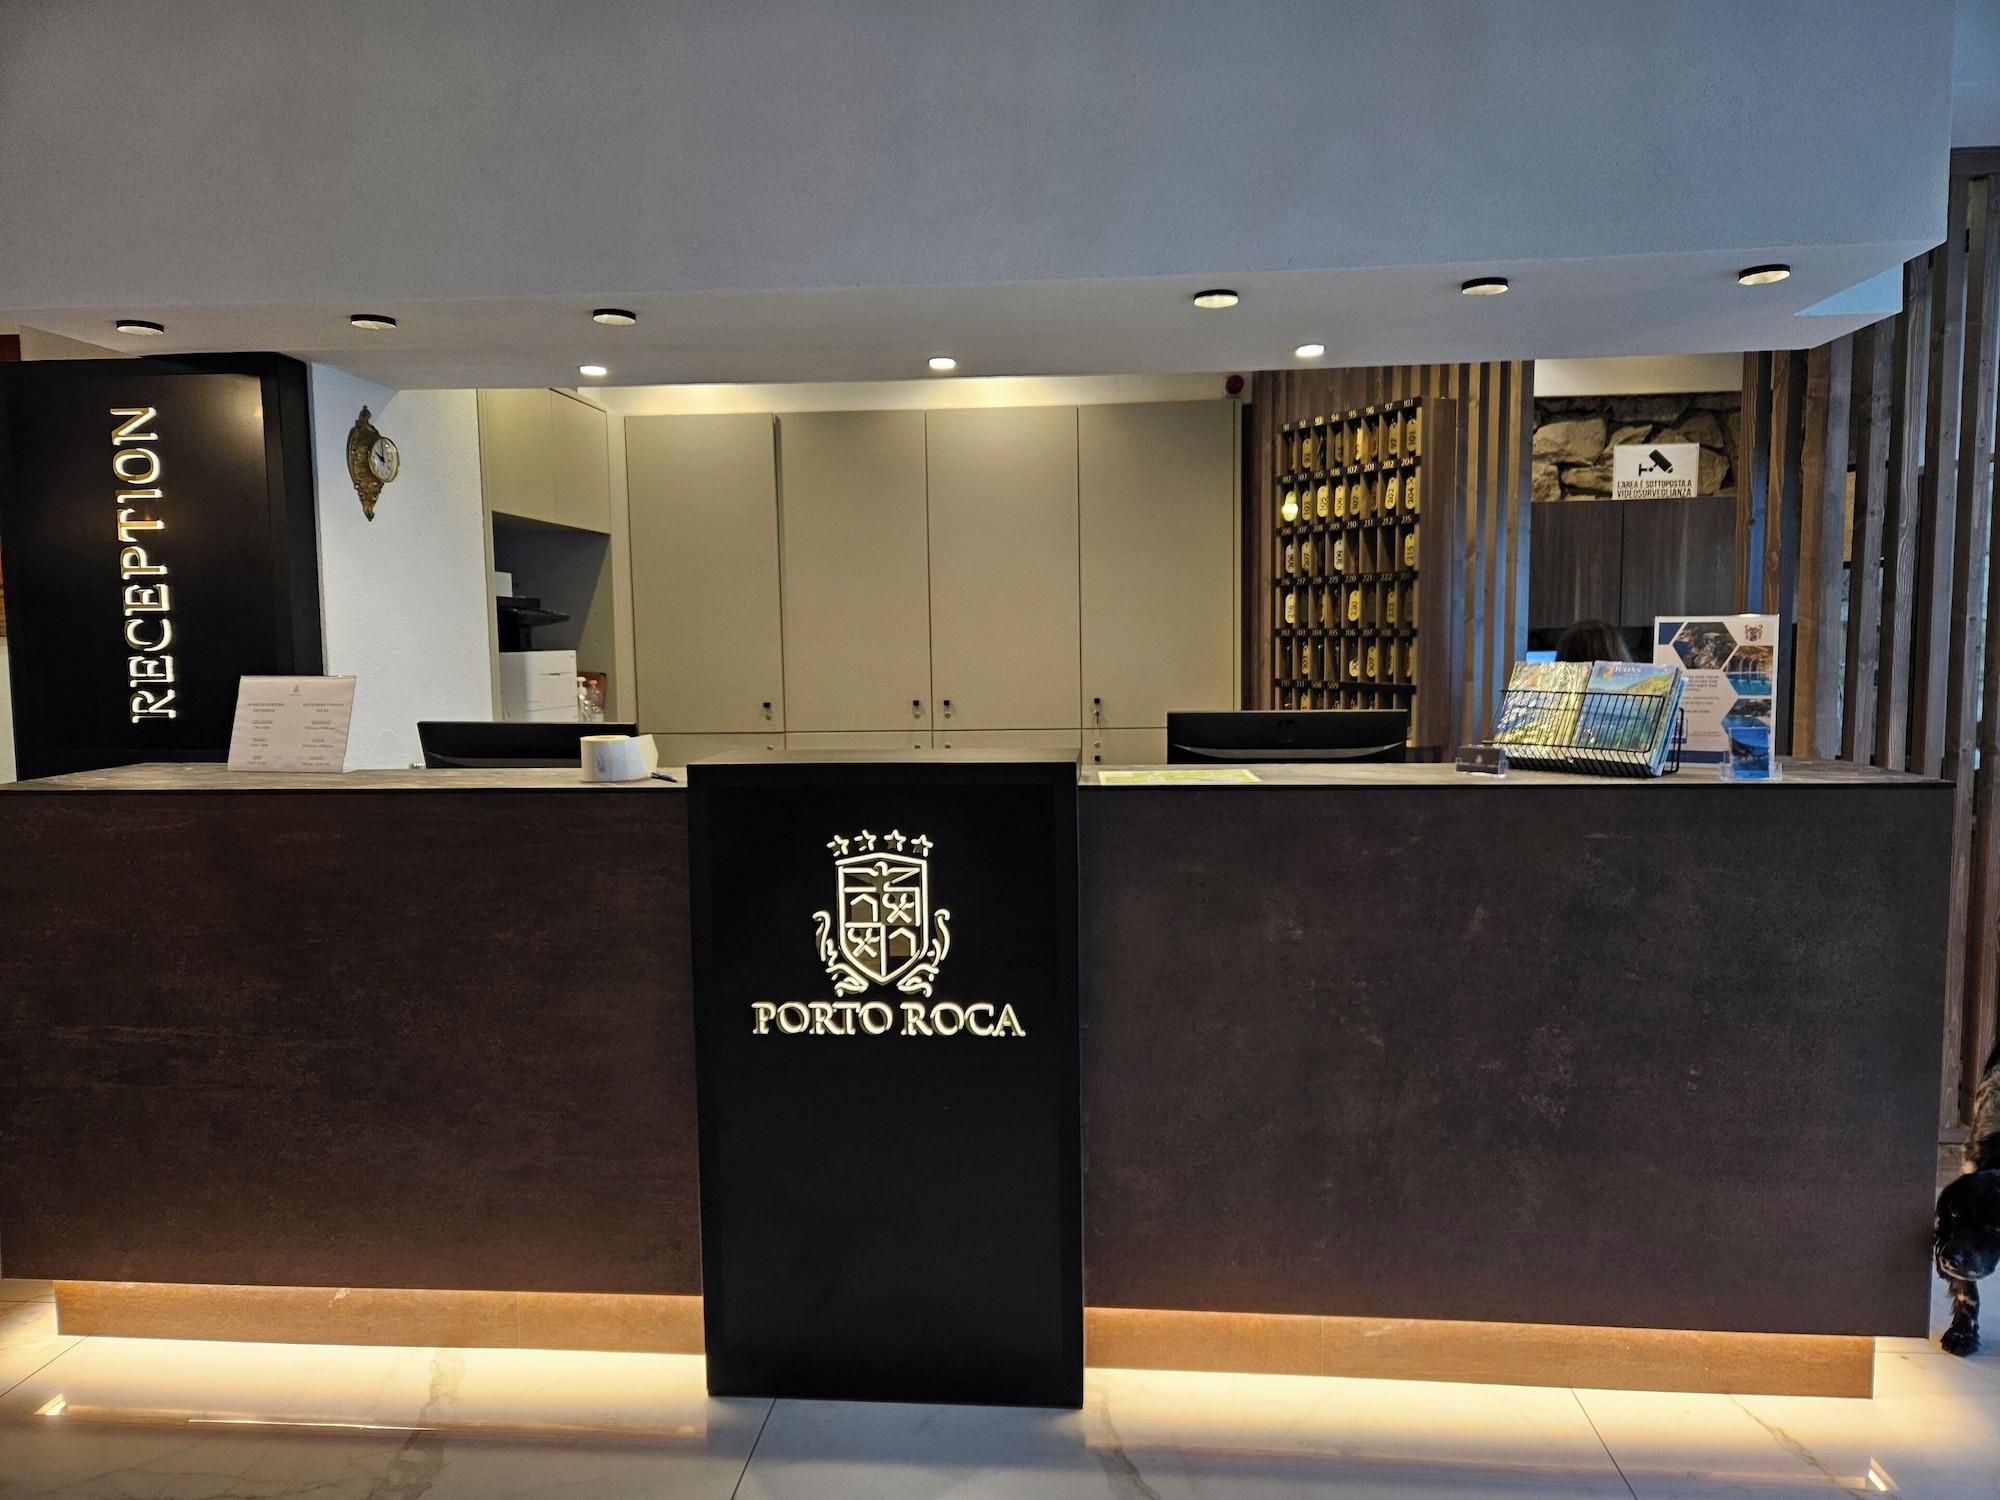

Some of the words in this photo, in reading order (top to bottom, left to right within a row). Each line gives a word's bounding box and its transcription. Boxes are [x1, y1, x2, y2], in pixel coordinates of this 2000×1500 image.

[1283, 424, 1289, 432] 91
[1299, 420, 1306, 428] 92
[1315, 416, 1324, 426] 93
[1331, 413, 1339, 422] 94
[1348, 410, 1357, 418] 95
[1366, 407, 1374, 415] 96
[1384, 403, 1393, 411] 97
[1403, 399, 1413, 408] 101
[1330, 468, 1340, 477] 106
[1347, 465, 1357, 474] 107
[1364, 463, 1374, 472] 201
[1382, 461, 1394, 469] 202
[1401, 458, 1413, 466] 204
[1617, 480, 1638, 488] L'AREA
[1646, 479, 1685, 488] SOTTOPOSTA
[1687, 479, 1692, 487] A
[1617, 488, 1691, 498] VIDEOSORVEGLIANZA
[1329, 522, 1340, 531] 209
[1346, 521, 1357, 529] 210
[1364, 519, 1373, 528] 211
[1381, 517, 1393, 526] 212
[1401, 515, 1411, 524] 215
[110, 407, 176, 723] RECEPTION
[1344, 575, 1357, 583] 220
[1362, 574, 1372, 582] 221
[1380, 572, 1392, 582] 222
[1362, 629, 1373, 637] 307
[751, 1001, 893, 1035] PORTO
[900, 1001, 1026, 1037] ROCA
